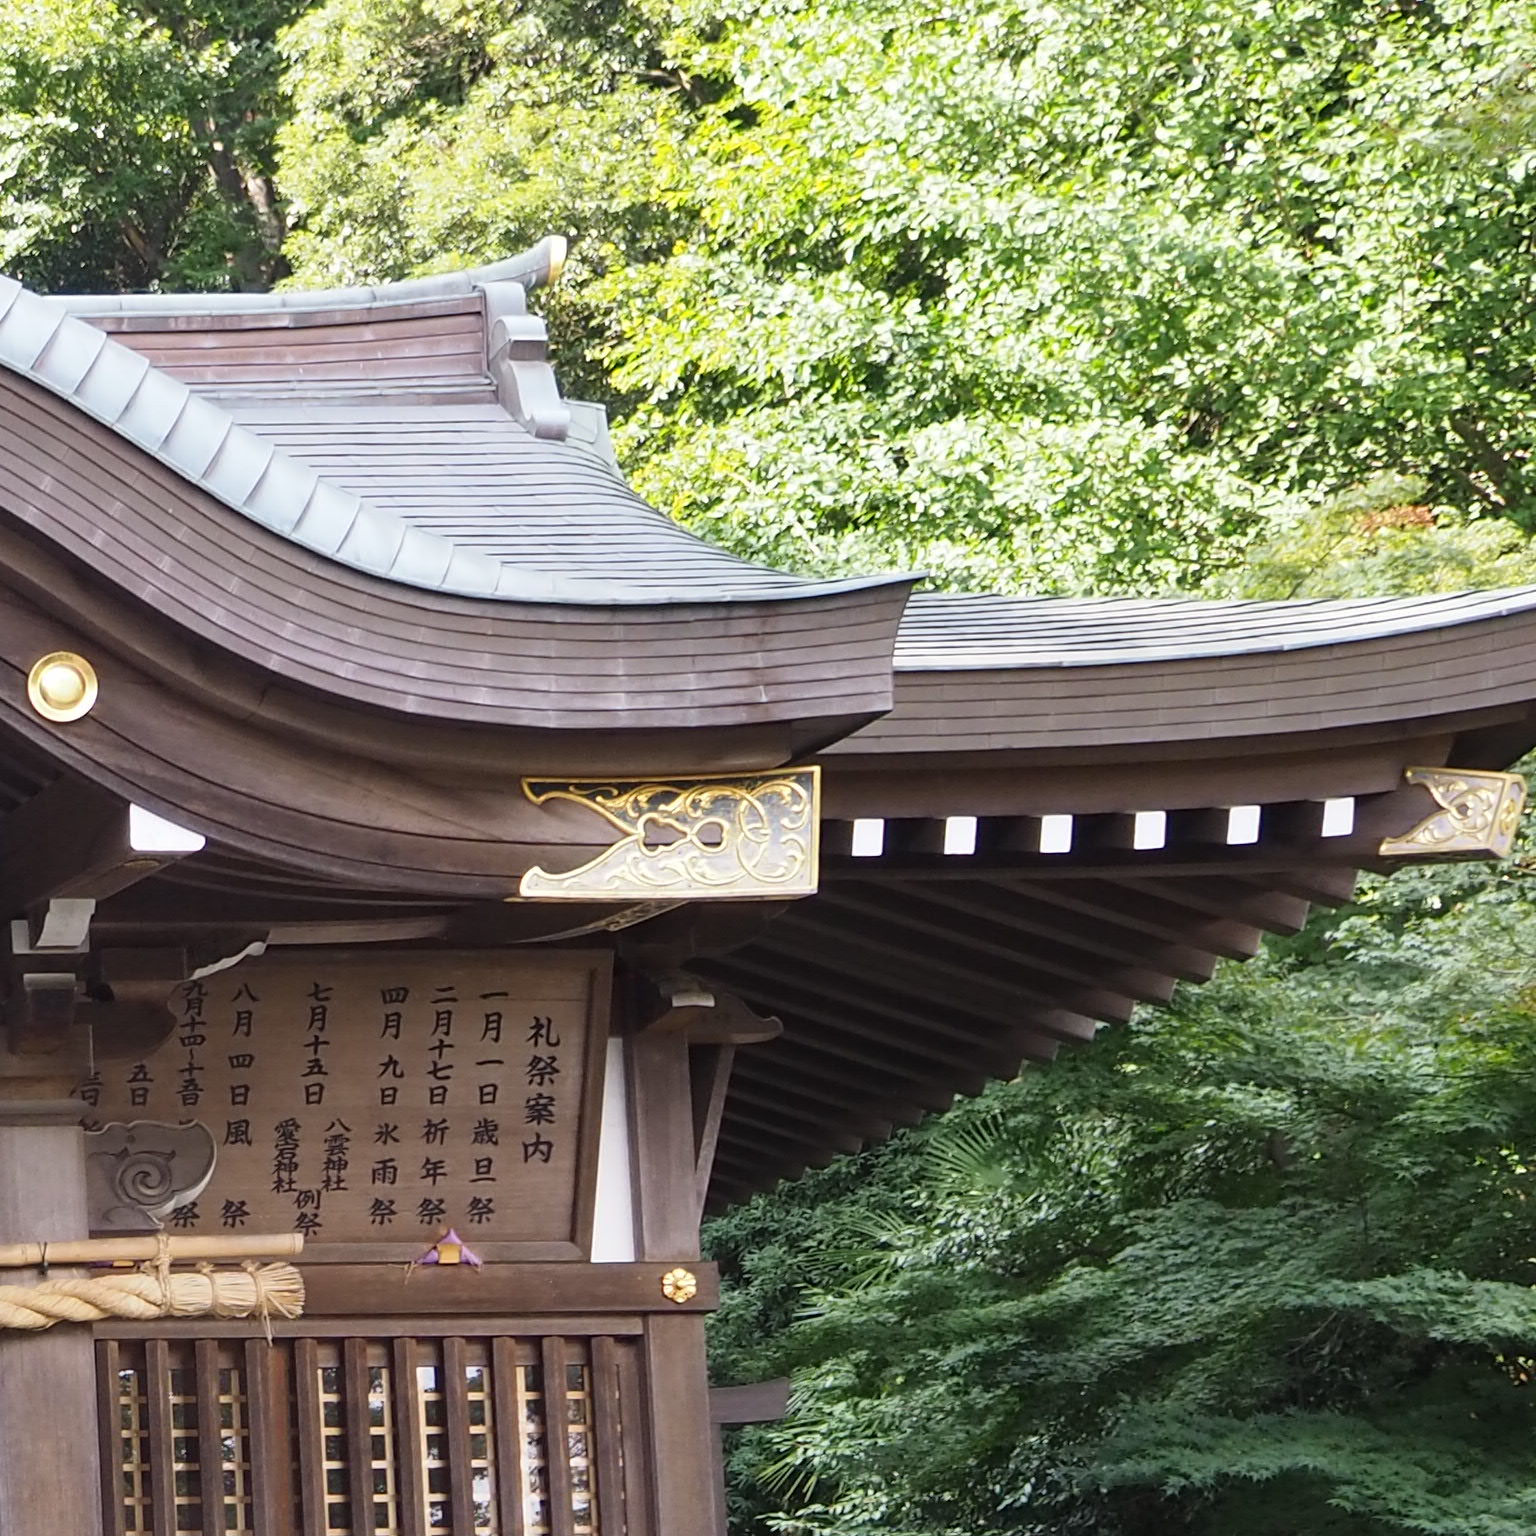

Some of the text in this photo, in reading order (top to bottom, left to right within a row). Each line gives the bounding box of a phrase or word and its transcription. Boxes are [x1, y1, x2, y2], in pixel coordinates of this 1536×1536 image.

[300, 983, 334, 1105] 七月十五日
[522, 1016, 560, 1164] 礼祭案内
[271, 1118, 302, 1194] 愛宕神社
[321, 1118, 352, 1192] 八雲神社
[294, 1189, 322, 1237] 例祭
